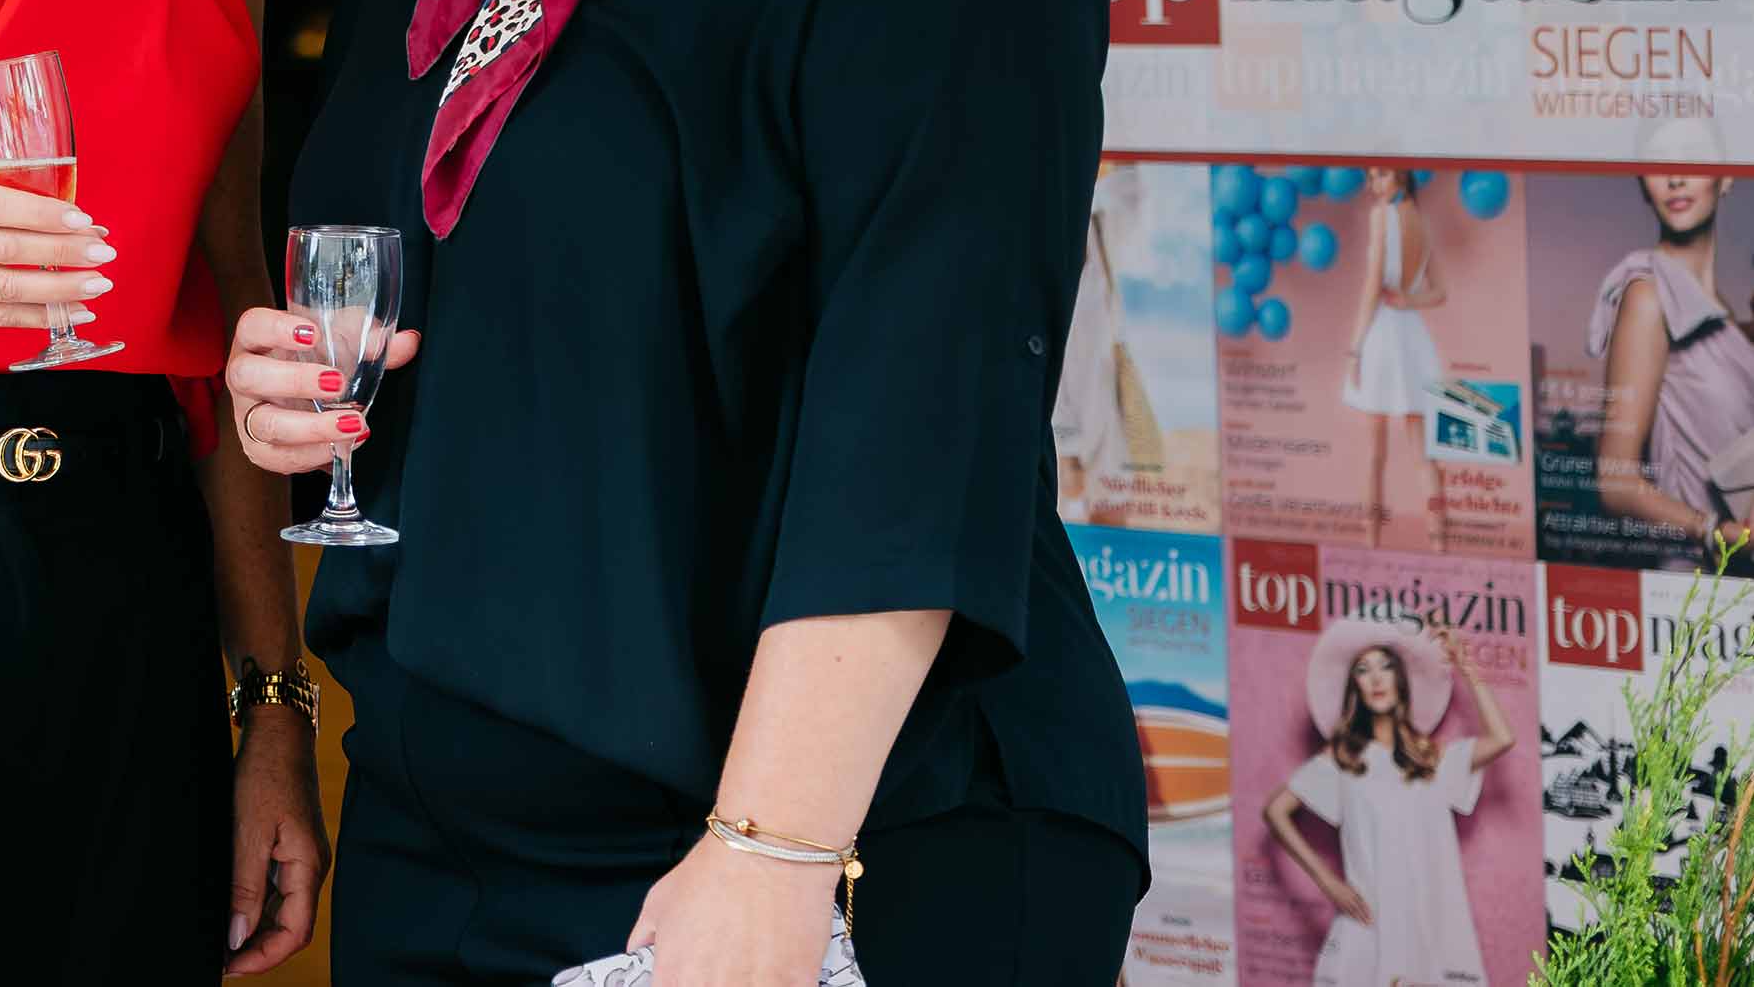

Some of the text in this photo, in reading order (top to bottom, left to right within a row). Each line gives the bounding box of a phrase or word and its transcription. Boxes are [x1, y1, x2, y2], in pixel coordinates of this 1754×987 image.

[1531, 27, 1714, 79] SIEGEN
[1532, 92, 1714, 119] WITTGENSTEIN
[1238, 563, 1527, 637] top magazin
[1552, 594, 1640, 663] top
